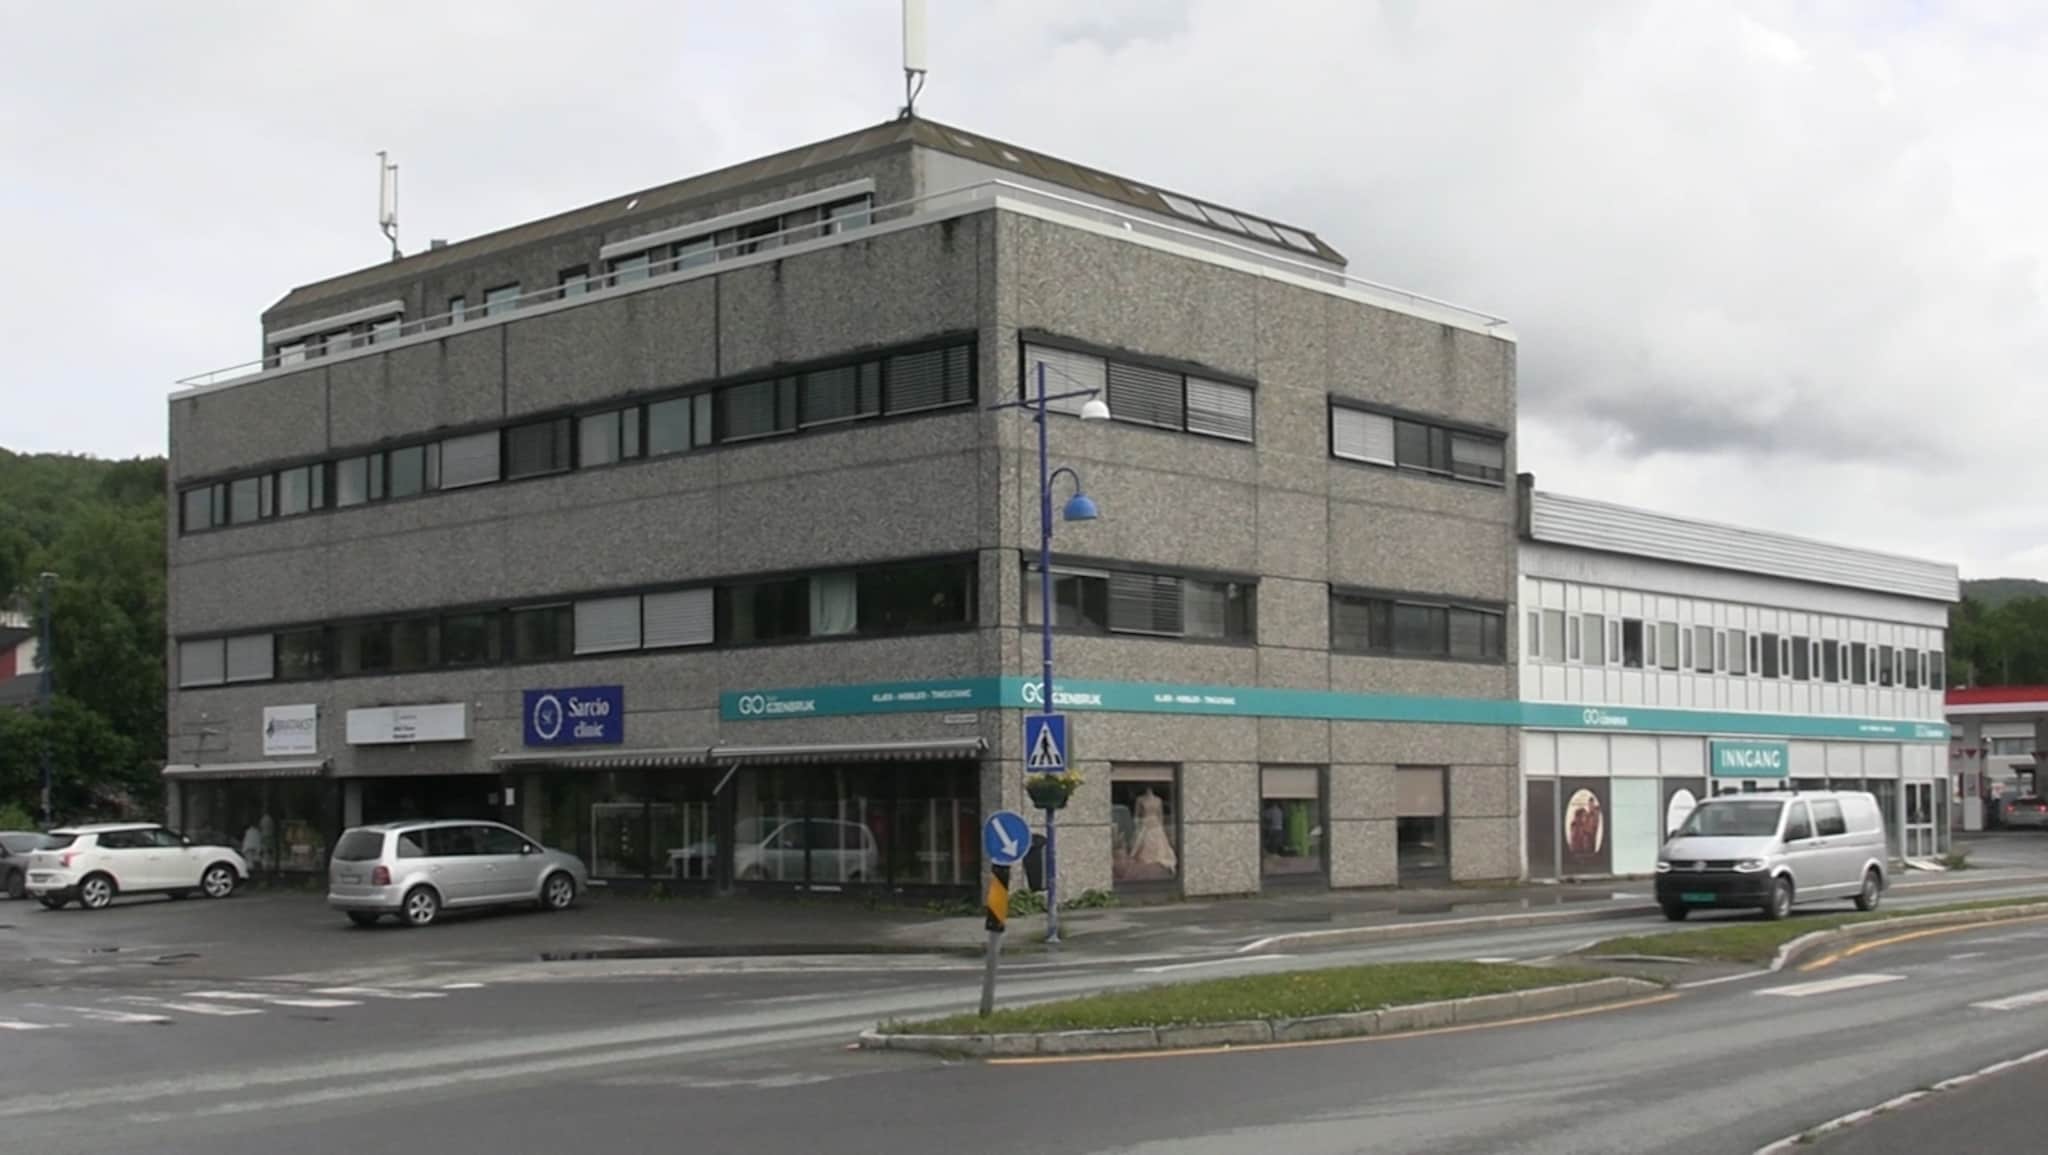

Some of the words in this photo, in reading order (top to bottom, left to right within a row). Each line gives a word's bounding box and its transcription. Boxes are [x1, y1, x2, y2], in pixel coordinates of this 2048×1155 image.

[568, 697, 610, 717] Sarcio
[738, 694, 765, 714] GO
[574, 721, 605, 738] clinic
[1720, 749, 1780, 768] INNGANG
